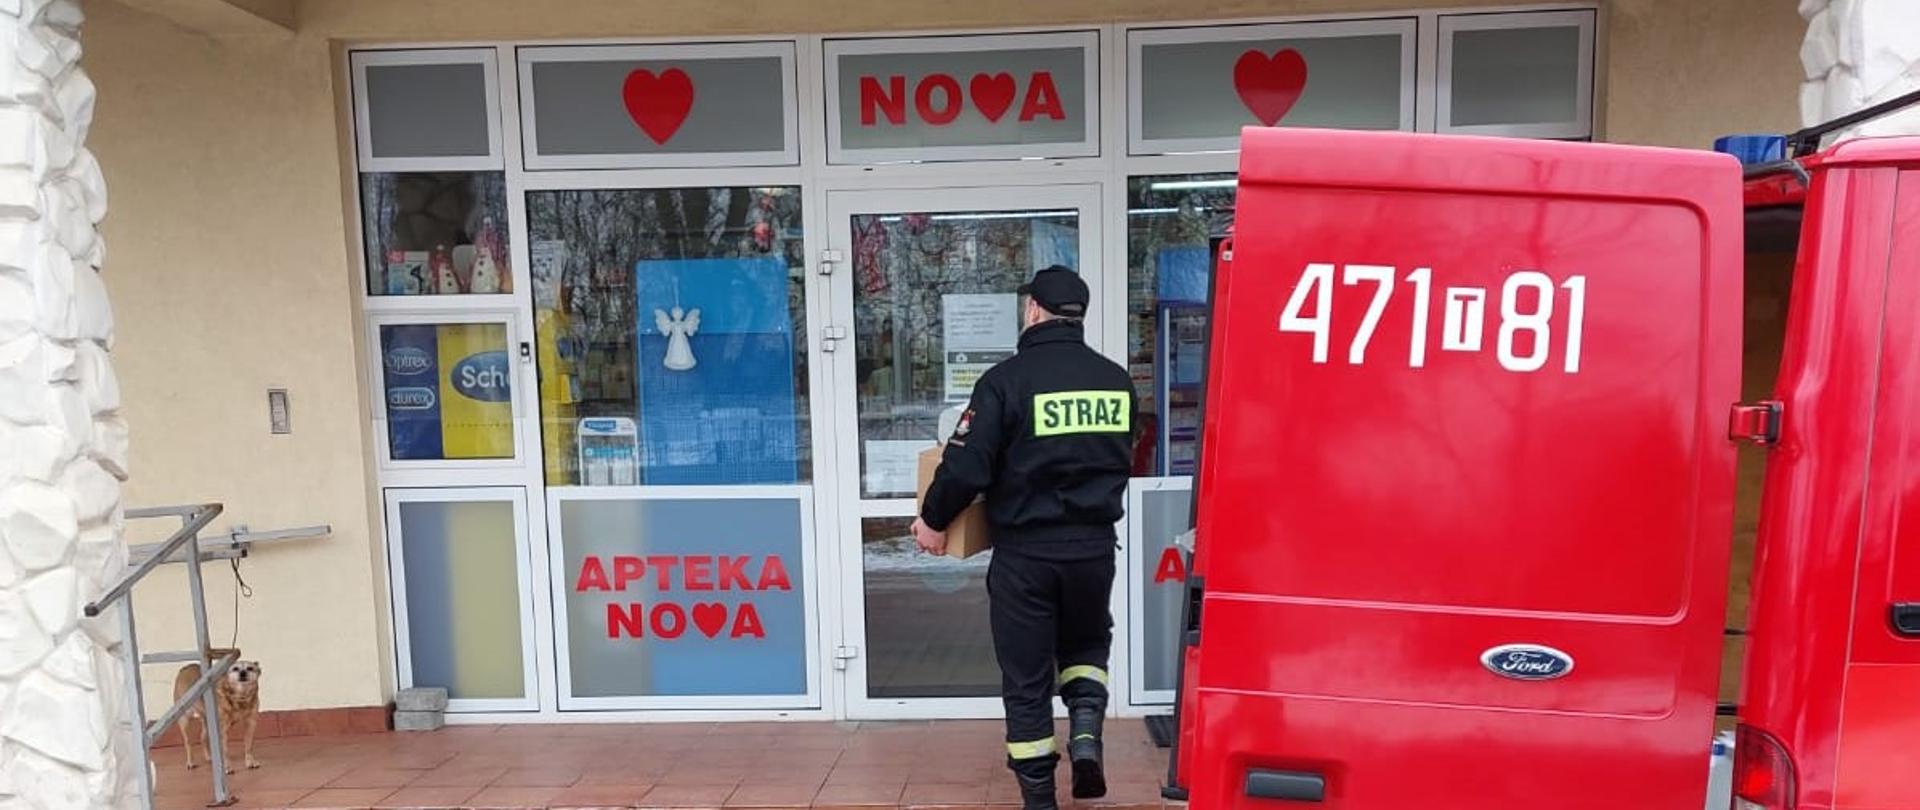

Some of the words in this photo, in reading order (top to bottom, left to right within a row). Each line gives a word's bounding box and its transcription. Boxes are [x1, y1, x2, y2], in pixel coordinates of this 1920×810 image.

[461, 365, 511, 388] Sch
[576, 555, 792, 592] APTEKA
[1502, 652, 1555, 673] Ford
